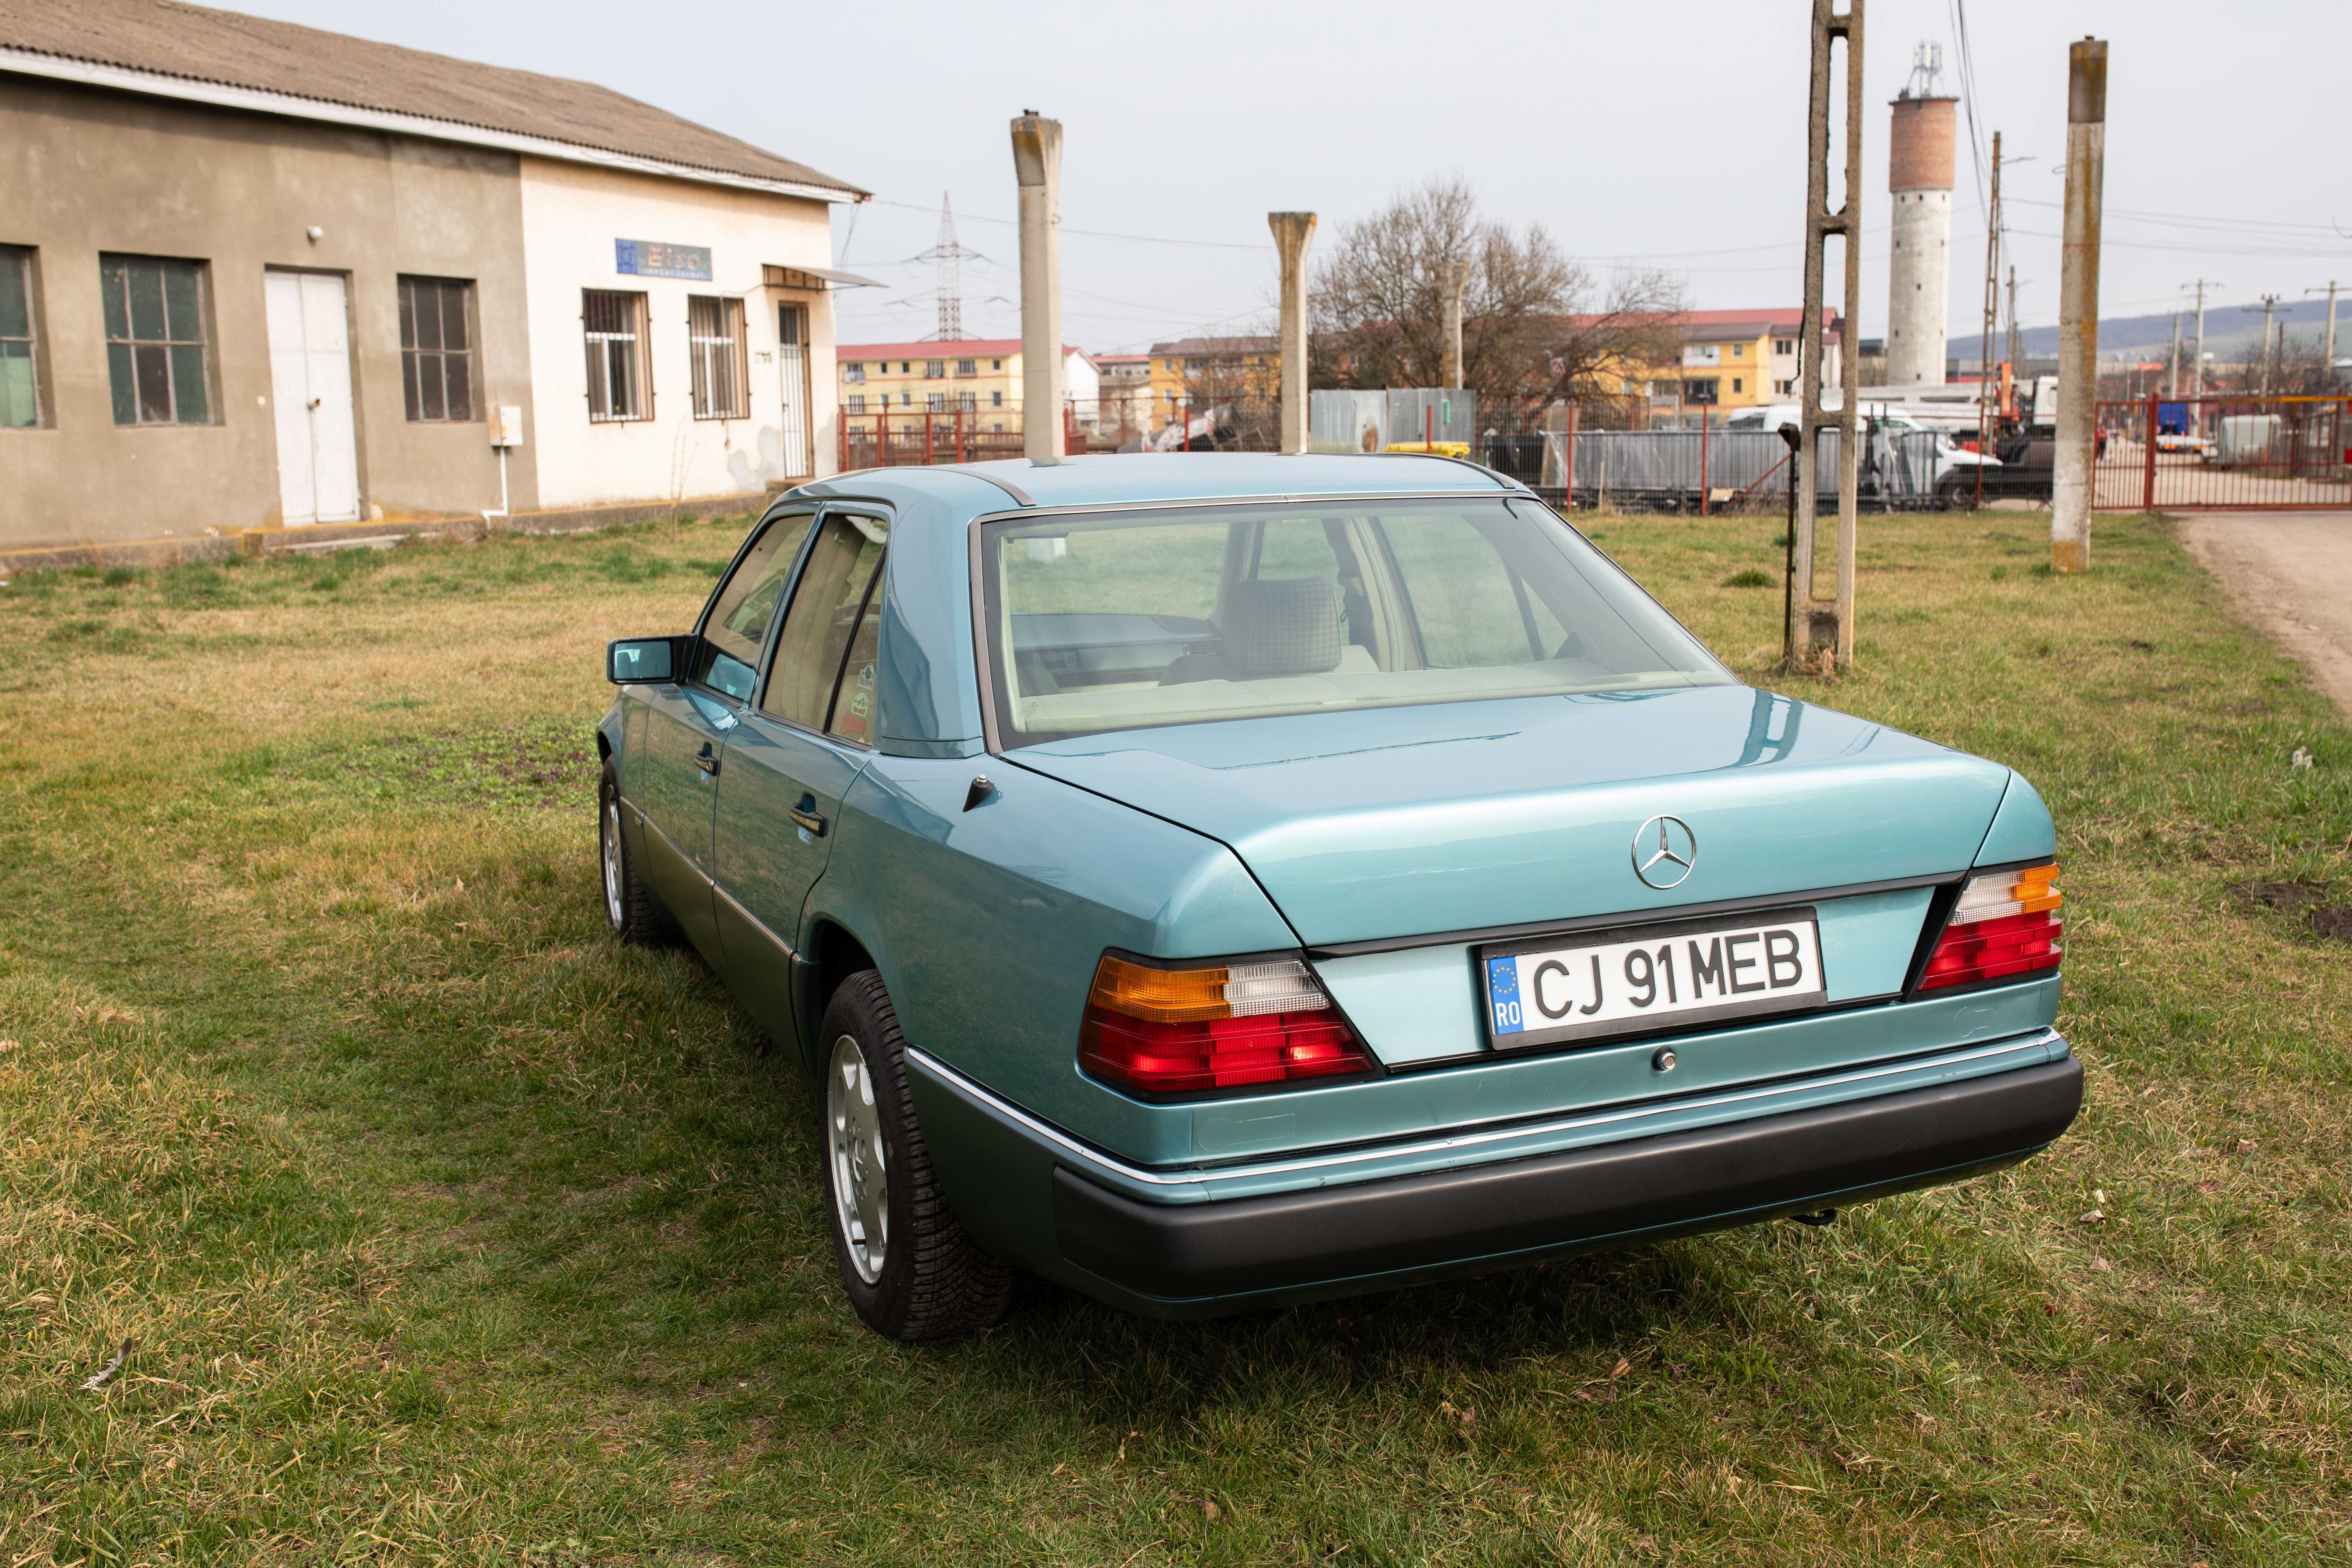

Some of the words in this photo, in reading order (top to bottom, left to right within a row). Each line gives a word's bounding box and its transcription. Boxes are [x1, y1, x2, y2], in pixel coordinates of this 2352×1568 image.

[1534, 954, 1602, 1019] CJ
[1624, 945, 1677, 1007] 91
[1688, 929, 1802, 998] MEB
[1496, 1001, 1520, 1026] RO
